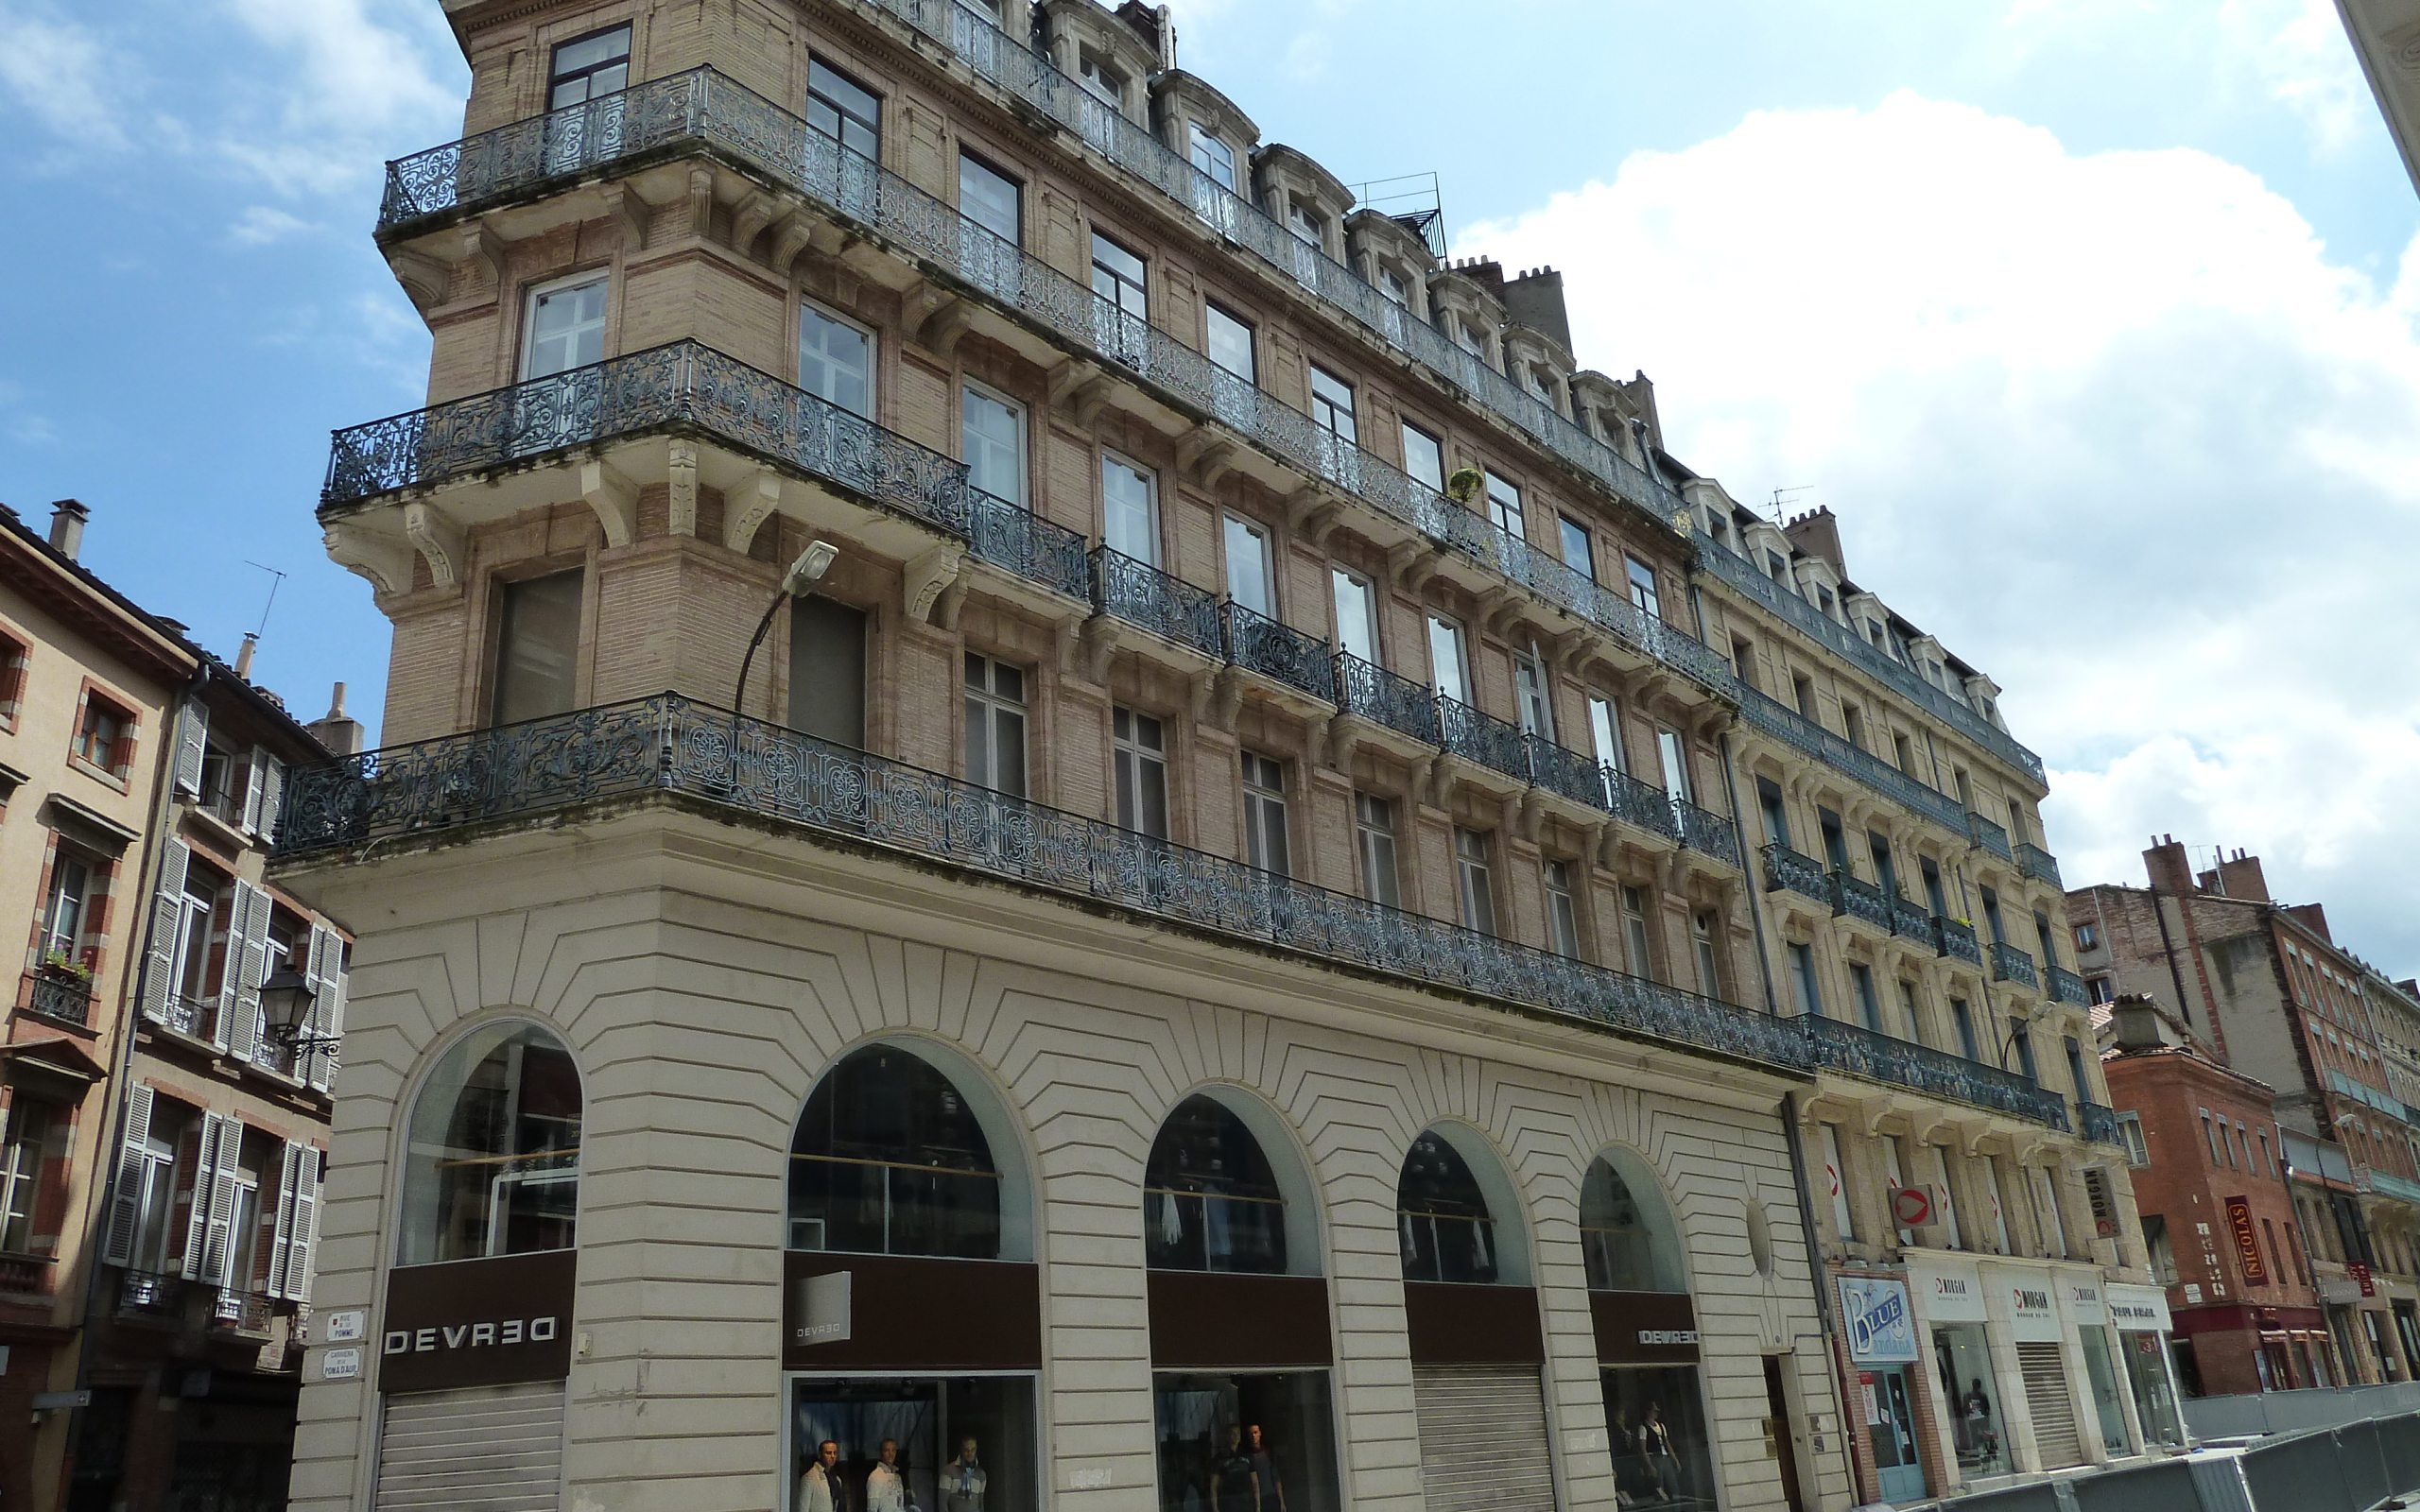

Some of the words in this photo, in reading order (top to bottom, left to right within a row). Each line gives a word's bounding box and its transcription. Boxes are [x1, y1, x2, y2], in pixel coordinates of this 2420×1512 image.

[2084, 1170, 2107, 1217] MORGAN
[2233, 1208, 2260, 1273] NICOLAS
[1943, 1279, 1966, 1294] MORGAN
[2079, 1288, 2097, 1301] MORGAN
[2022, 1291, 2048, 1309] MORGAN
[335, 1329, 354, 1338] POMME
[385, 1316, 556, 1355] DEVRED
